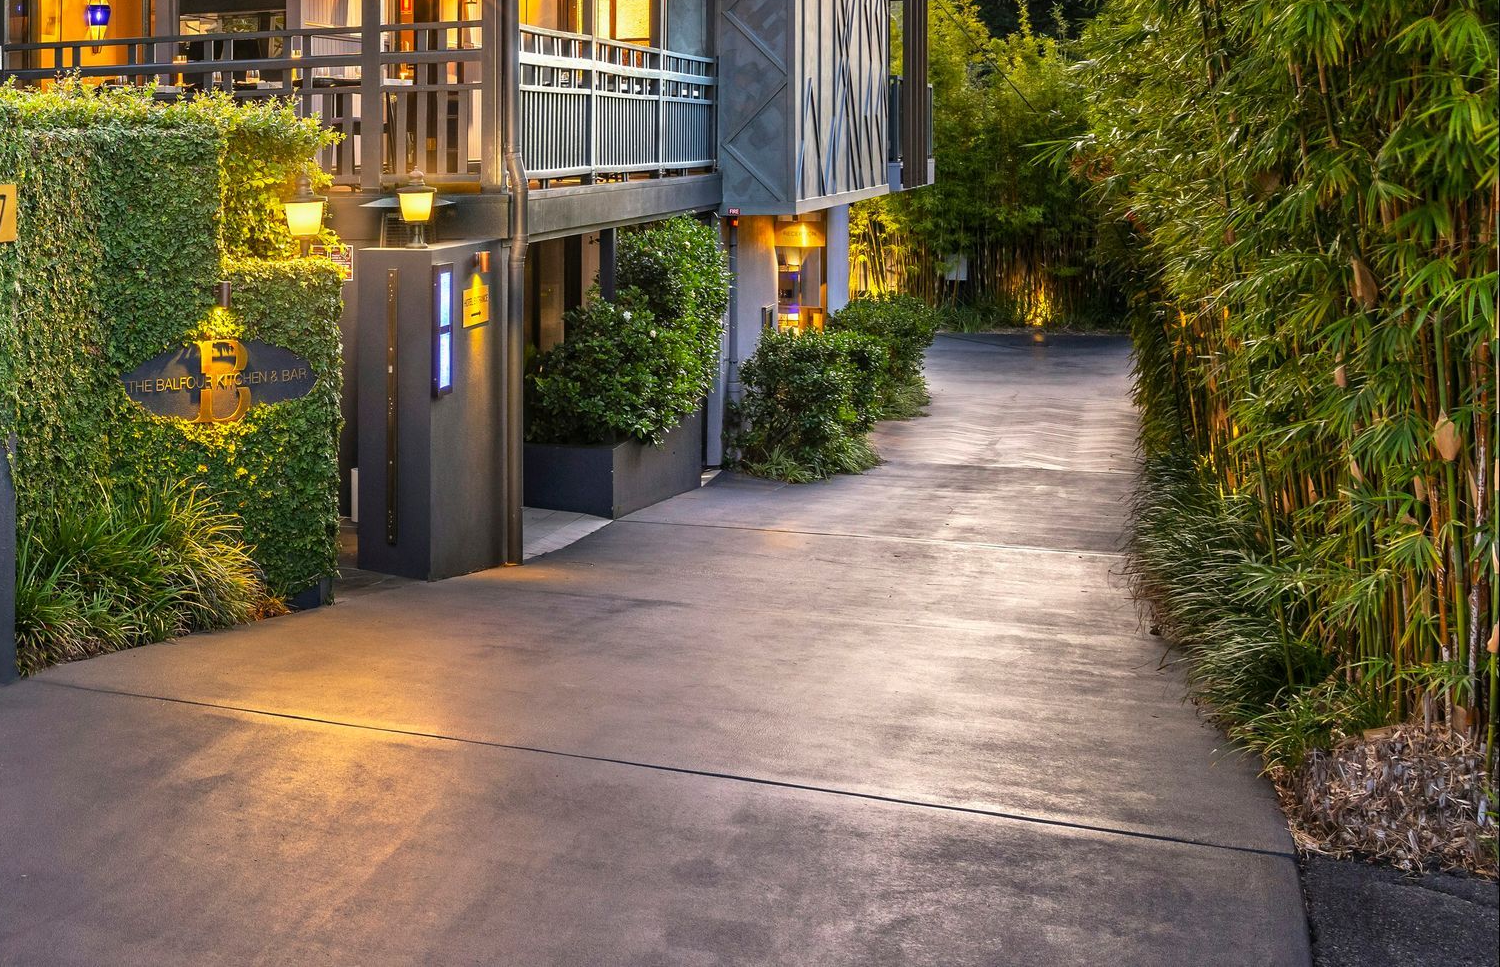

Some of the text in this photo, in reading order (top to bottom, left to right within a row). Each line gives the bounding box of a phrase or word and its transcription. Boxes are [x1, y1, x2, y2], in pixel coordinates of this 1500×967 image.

[129, 367, 308, 394] THE BALFOUR KITCHEN & BAR
